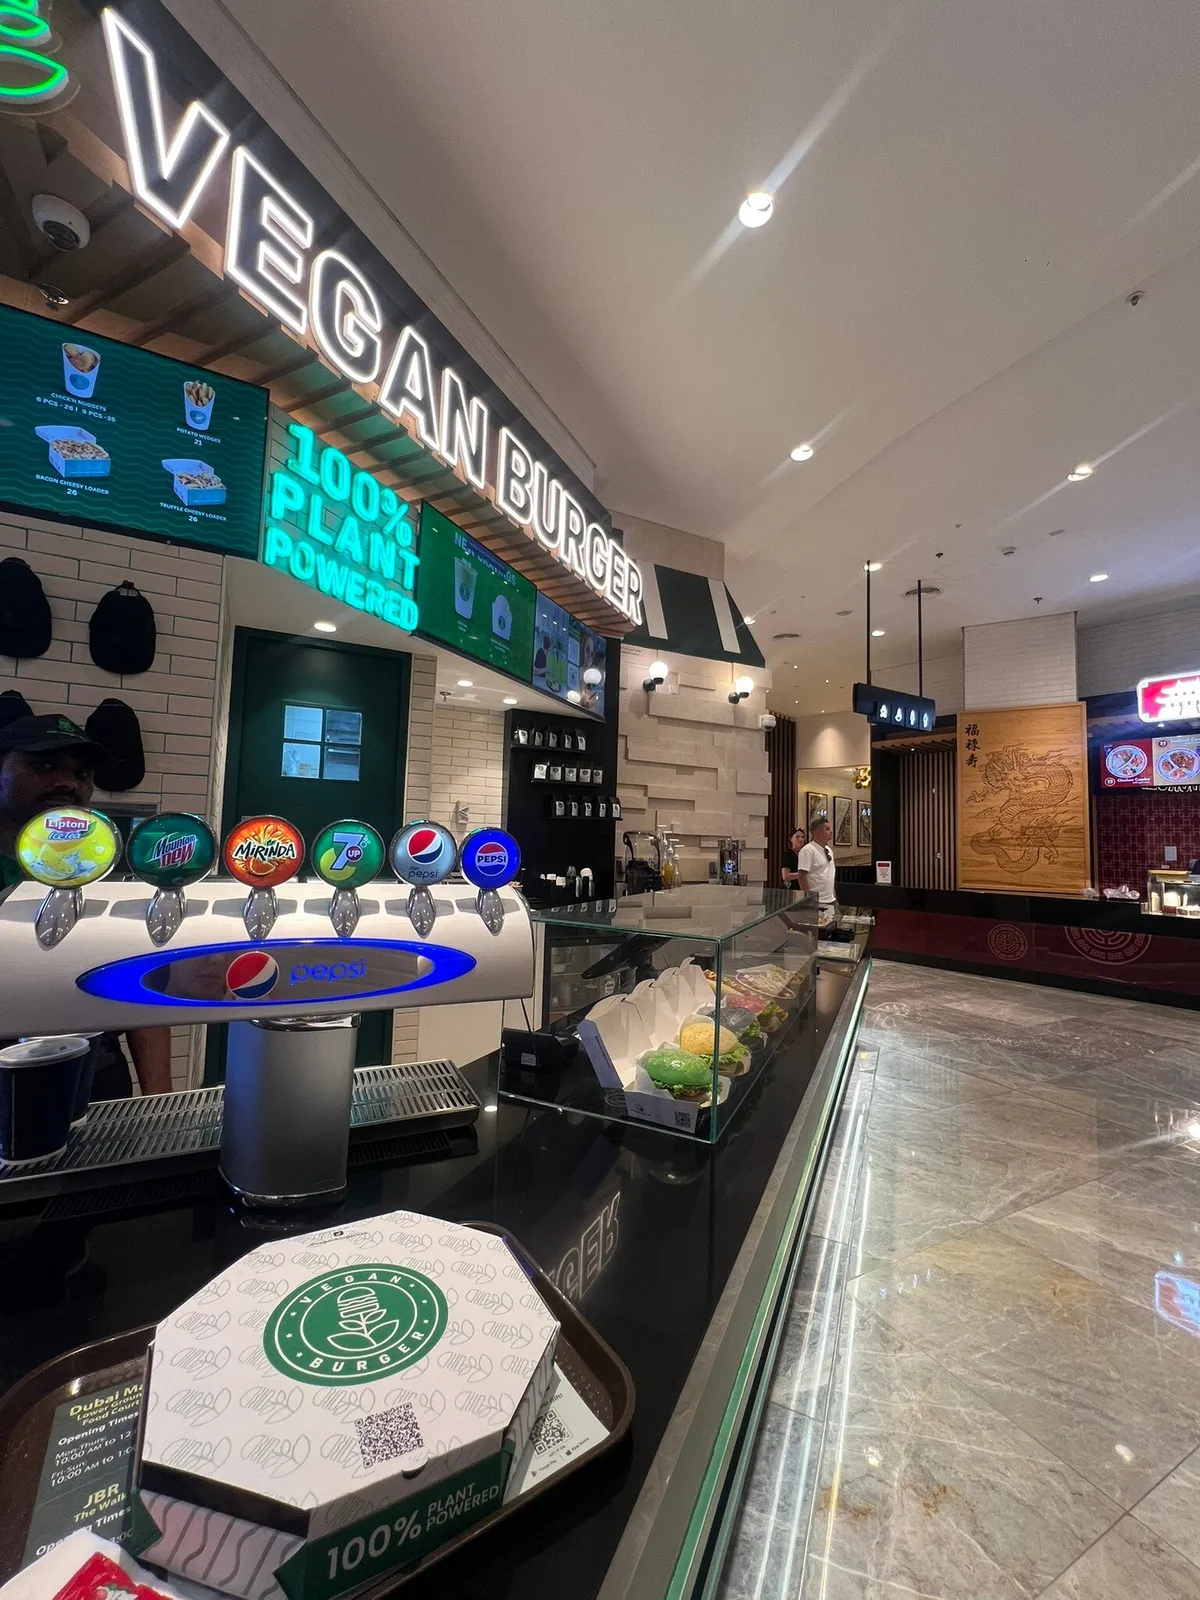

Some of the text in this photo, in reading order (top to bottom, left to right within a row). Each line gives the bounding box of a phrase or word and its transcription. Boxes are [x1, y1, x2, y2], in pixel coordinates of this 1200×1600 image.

[102, 8, 644, 626] VEGAN BURGER
[43, 398, 59, 407] PCS
[64, 403, 74, 411] 26
[88, 410, 103, 419] PCS
[50, 392, 107, 412] CHICK'N NUGGETS
[176, 427, 222, 444] POTATO WEDGES
[194, 438, 203, 446] 21
[35, 474, 109, 495] BACON CHEESY LOADER
[66, 488, 78, 496] 26
[287, 423, 414, 548] 100%
[160, 502, 227, 522] TRUFFLE CHEESY LOADER
[188, 515, 198, 523] 26
[271, 471, 420, 591] PLANT
[264, 526, 419, 631] POWERED
[48, 819, 85, 830] Lipton
[152, 834, 197, 860] Mountain
[476, 854, 507, 864] PEPSI
[408, 869, 439, 880] pepsi
[289, 958, 367, 986] pepsi
[300, 1272, 402, 1305] VEGAN
[309, 1331, 425, 1373] BURGER
[69, 1391, 120, 1417] Dubai
[76, 1406, 110, 1421] Lower
[82, 1399, 140, 1426] Food Court
[58, 1411, 139, 1446] Opening Times
[55, 1451, 85, 1467] 10:00
[87, 1443, 102, 1455] AM
[105, 1437, 117, 1448] to
[51, 1469, 82, 1488] 10:00
[84, 1462, 100, 1473] AM
[102, 1455, 114, 1465] to
[73, 1492, 127, 1524] The Walk
[83, 1483, 120, 1509] JBR
[426, 1484, 499, 1532] POWERED
[427, 1482, 476, 1517] PLANT
[96, 1506, 132, 1528] Times
[327, 1509, 422, 1580] 100%
